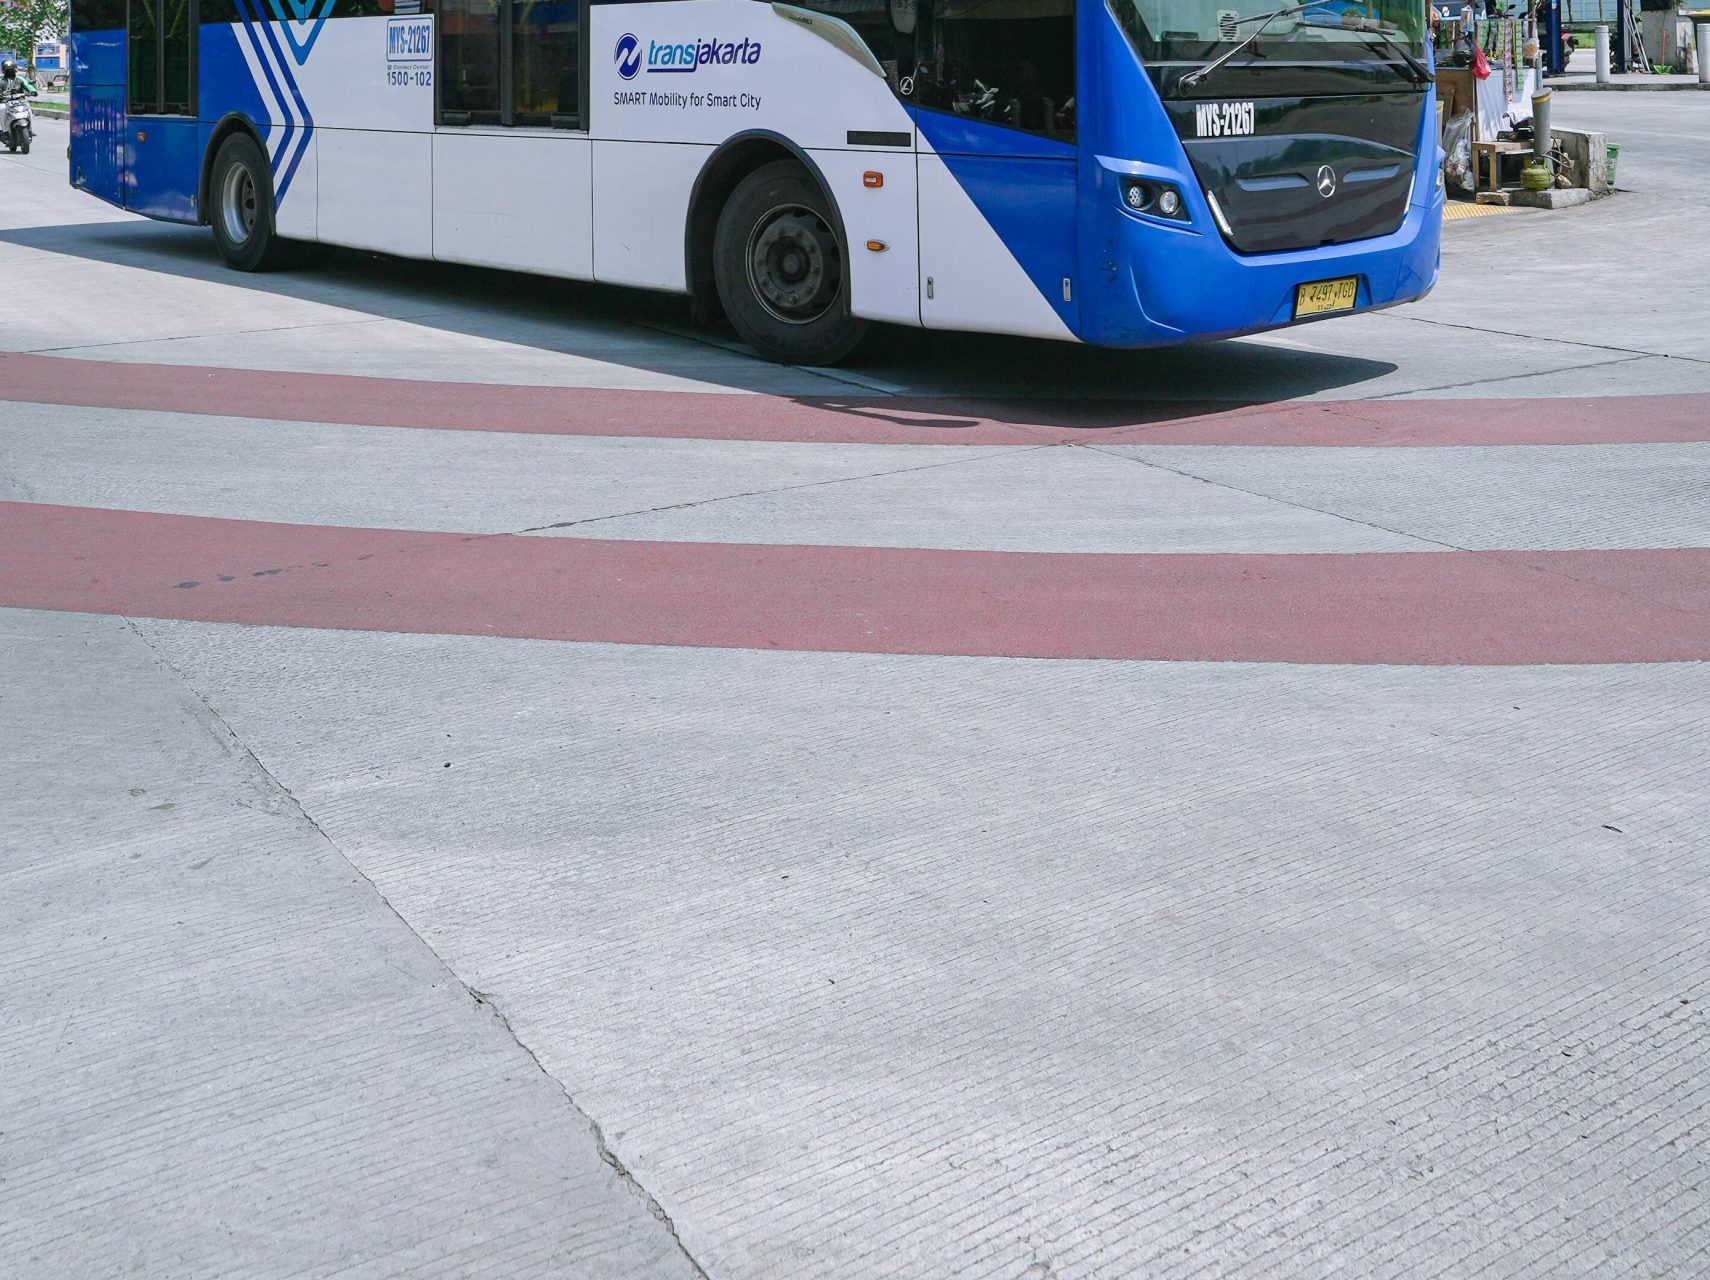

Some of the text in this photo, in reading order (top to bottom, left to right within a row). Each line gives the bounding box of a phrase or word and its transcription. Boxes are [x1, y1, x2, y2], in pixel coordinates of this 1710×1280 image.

[389, 24, 431, 54] MYS-21267
[647, 37, 762, 72] transjakarta
[387, 71, 432, 86] 1500-102
[613, 91, 762, 111] SMART Mobility for Smart City
[1195, 102, 1255, 137] MYS-21267
[1299, 281, 1355, 306] B 7497 TGD
